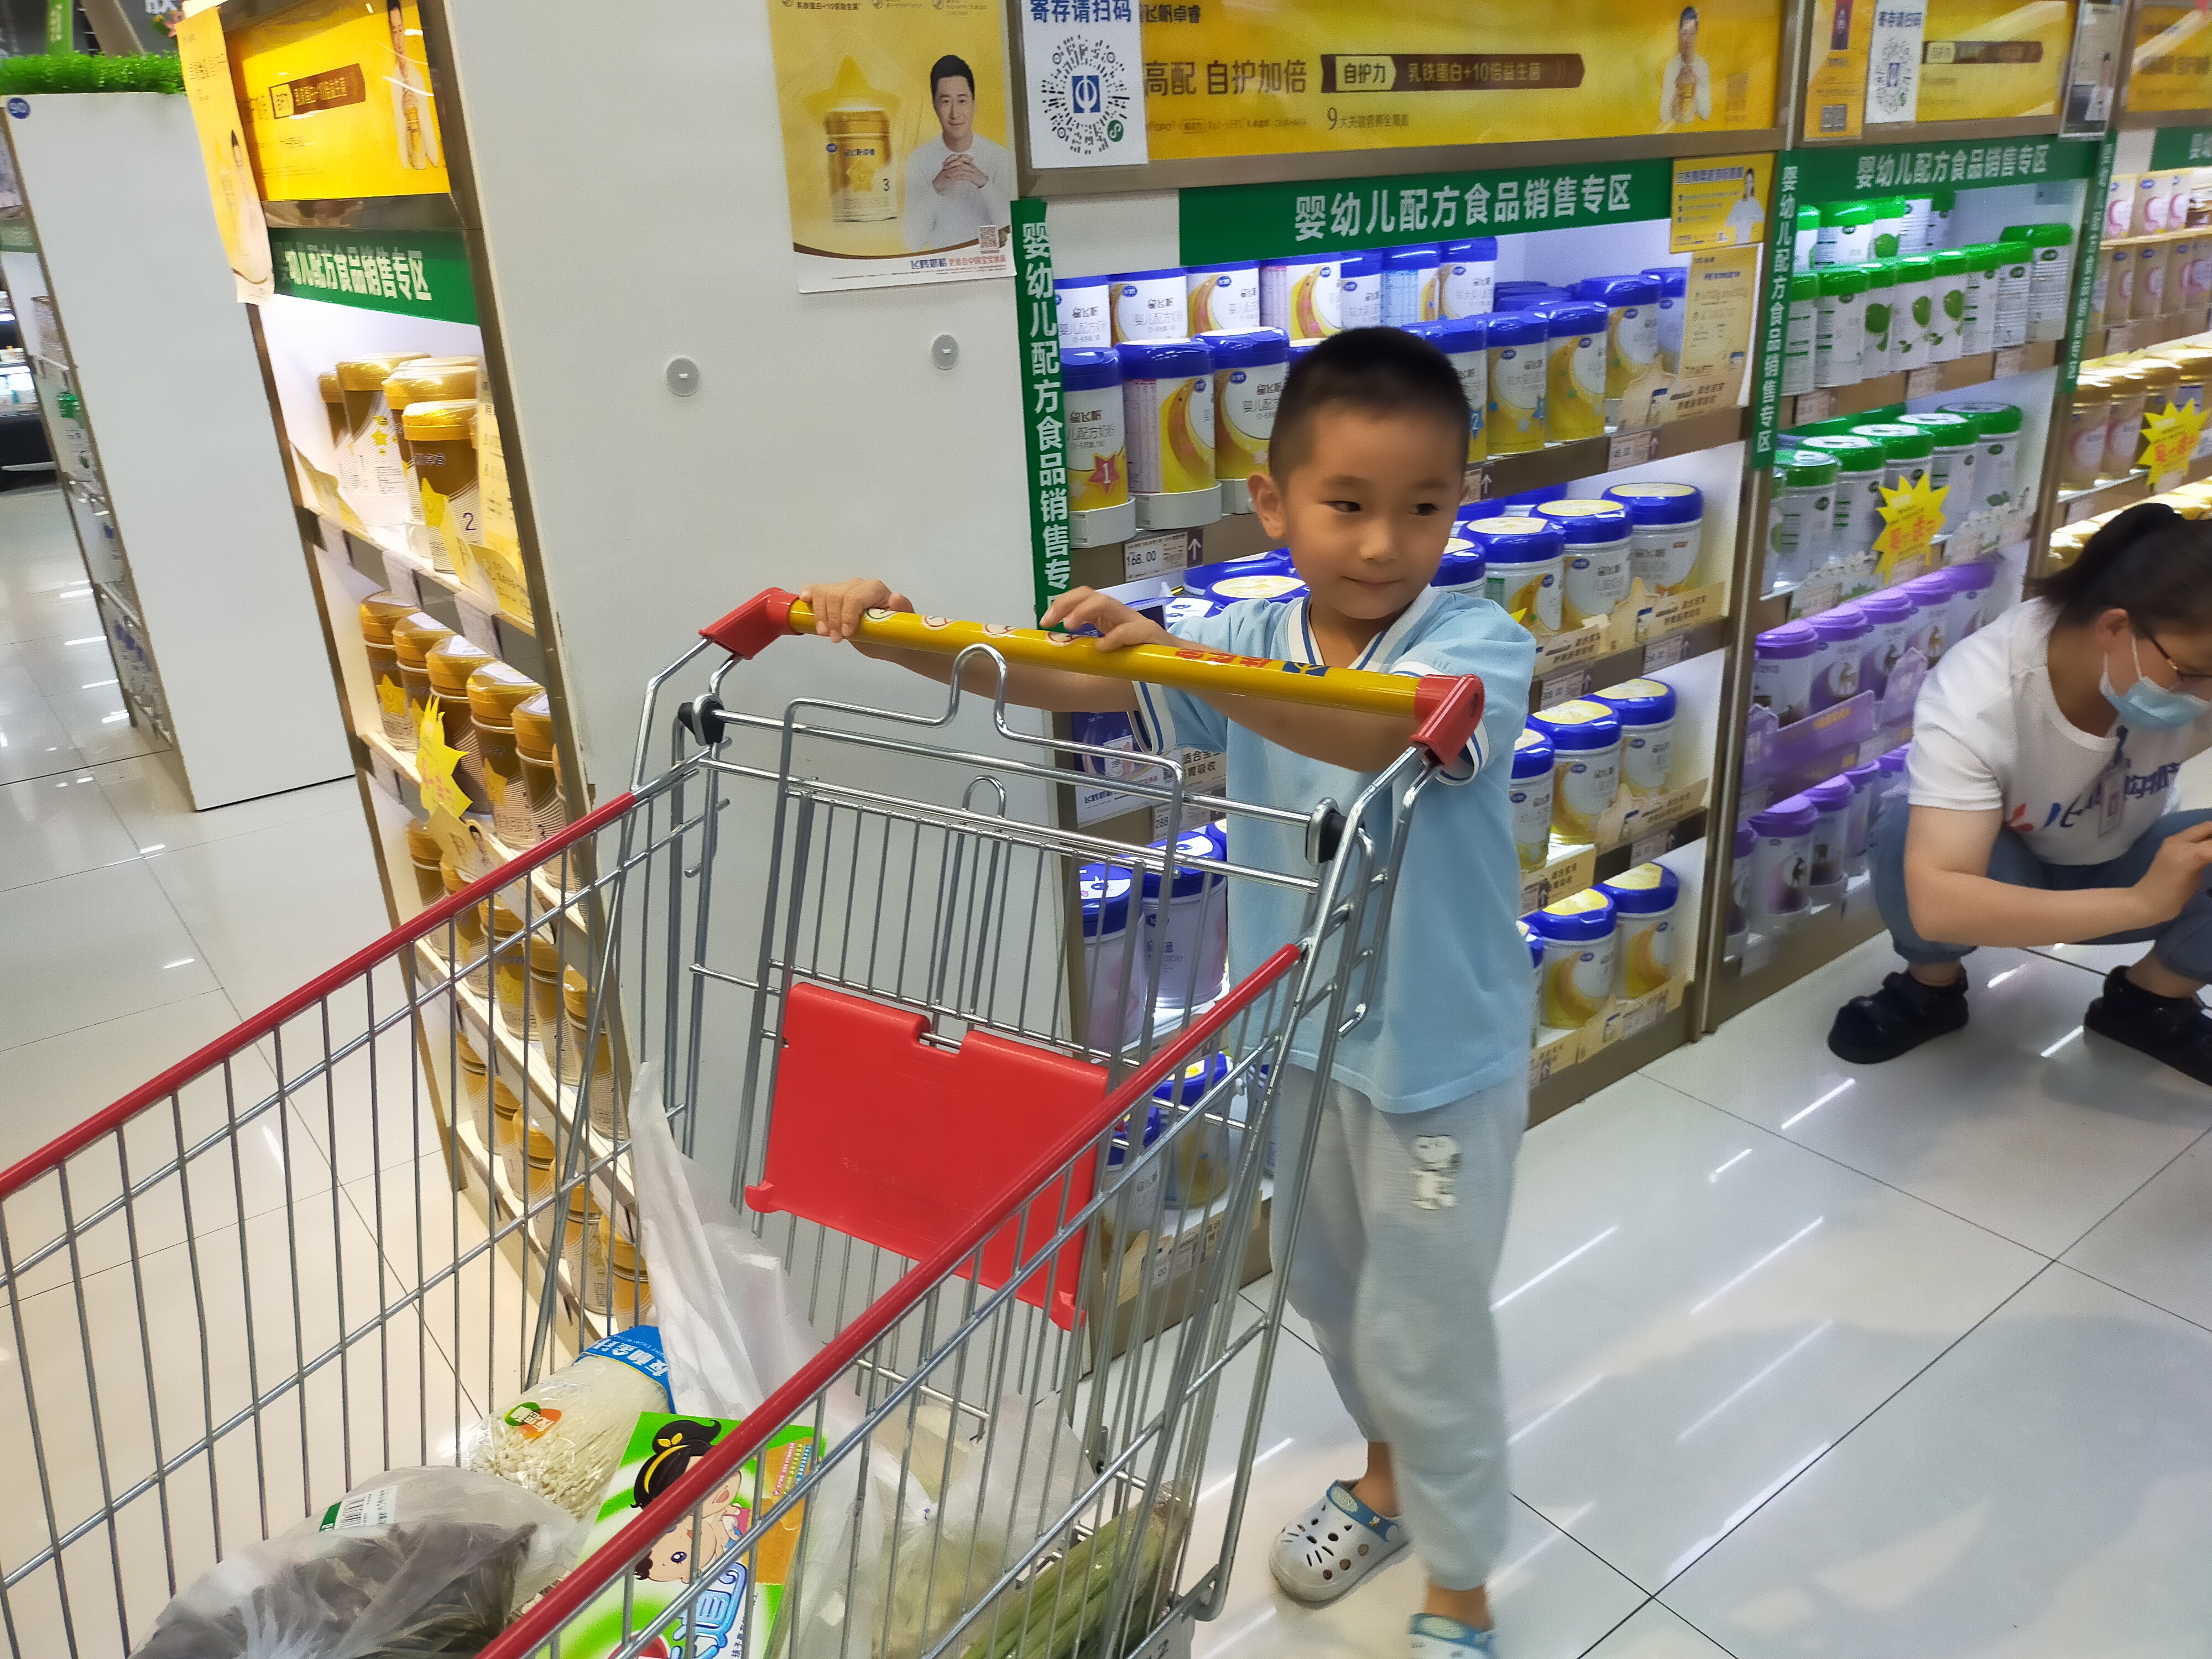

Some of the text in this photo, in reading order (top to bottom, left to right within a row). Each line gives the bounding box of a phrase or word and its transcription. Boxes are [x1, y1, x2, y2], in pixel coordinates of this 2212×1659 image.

[1030, 0, 1132, 23] 寄存请扫码
[1207, 59, 1307, 96] 自护加倍
[1344, 62, 1386, 85] 自护力
[883, 178, 890, 191] 3
[1295, 173, 1632, 242] 婴幼儿配方食品销售专区
[1103, 462, 1111, 484] 1
[463, 512, 477, 531] 2
[1126, 550, 1157, 566] 168.00
